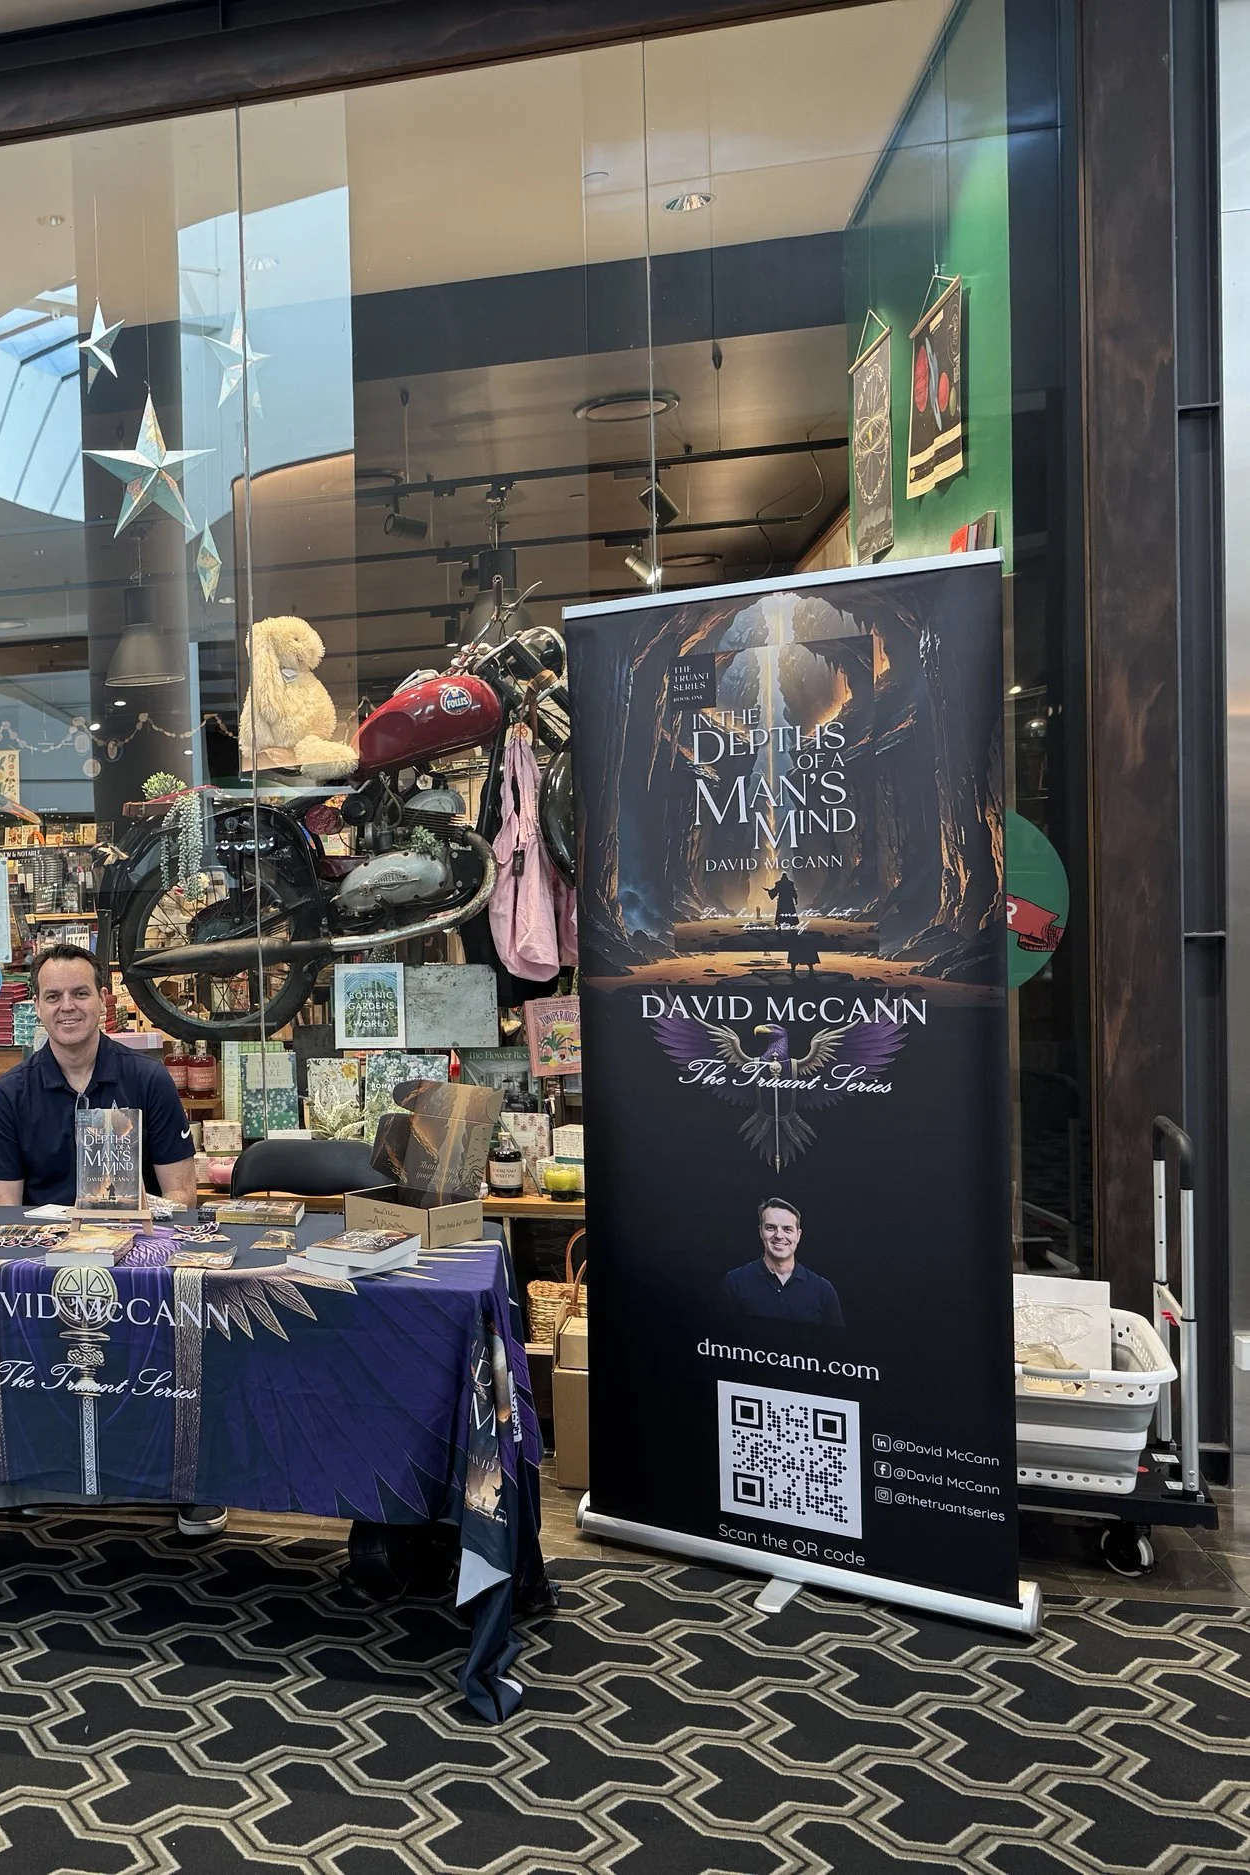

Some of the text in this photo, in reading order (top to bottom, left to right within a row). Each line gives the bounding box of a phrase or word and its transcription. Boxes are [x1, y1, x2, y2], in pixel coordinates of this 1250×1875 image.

[673, 673, 710, 683] TRUANT
[674, 665, 693, 674] THE
[673, 682, 706, 692] SERIES
[693, 708, 760, 730] IN THE
[692, 721, 846, 766] DEPTHS
[796, 751, 845, 770] OF A
[694, 770, 847, 826] MAN'S
[753, 808, 857, 850] MIND
[705, 855, 843, 872] DAVID McCANN
[700, 906, 731, 920] Time
[780, 907, 823, 919] master
[823, 906, 860, 921] but
[741, 921, 771, 931] time
[348, 991, 393, 1000] BOTANIC
[348, 1002, 395, 1010] GARDENS
[641, 994, 927, 1025] DAVID McCANN
[353, 1020, 390, 1028] WORLD
[469, 1051, 531, 1060] The Flower Roo
[678, 1058, 893, 1095] The Truant Series
[83, 1134, 131, 1147] DEPTHS
[83, 1149, 131, 1167] MAN'S
[102, 1161, 134, 1176] MIND
[74, 1297, 231, 1330] McCANN
[696, 1338, 881, 1381] dmmccann.com
[41, 1363, 128, 1395] Truant
[131, 1368, 198, 1400] Series
[892, 1440, 943, 1457] @David
[946, 1448, 1000, 1467] McCann
[893, 1467, 943, 1485] @David
[947, 1477, 1000, 1495] McCann
[894, 1492, 1006, 1522] @thetruantseries
[718, 1523, 866, 1566] Scan the QR code
